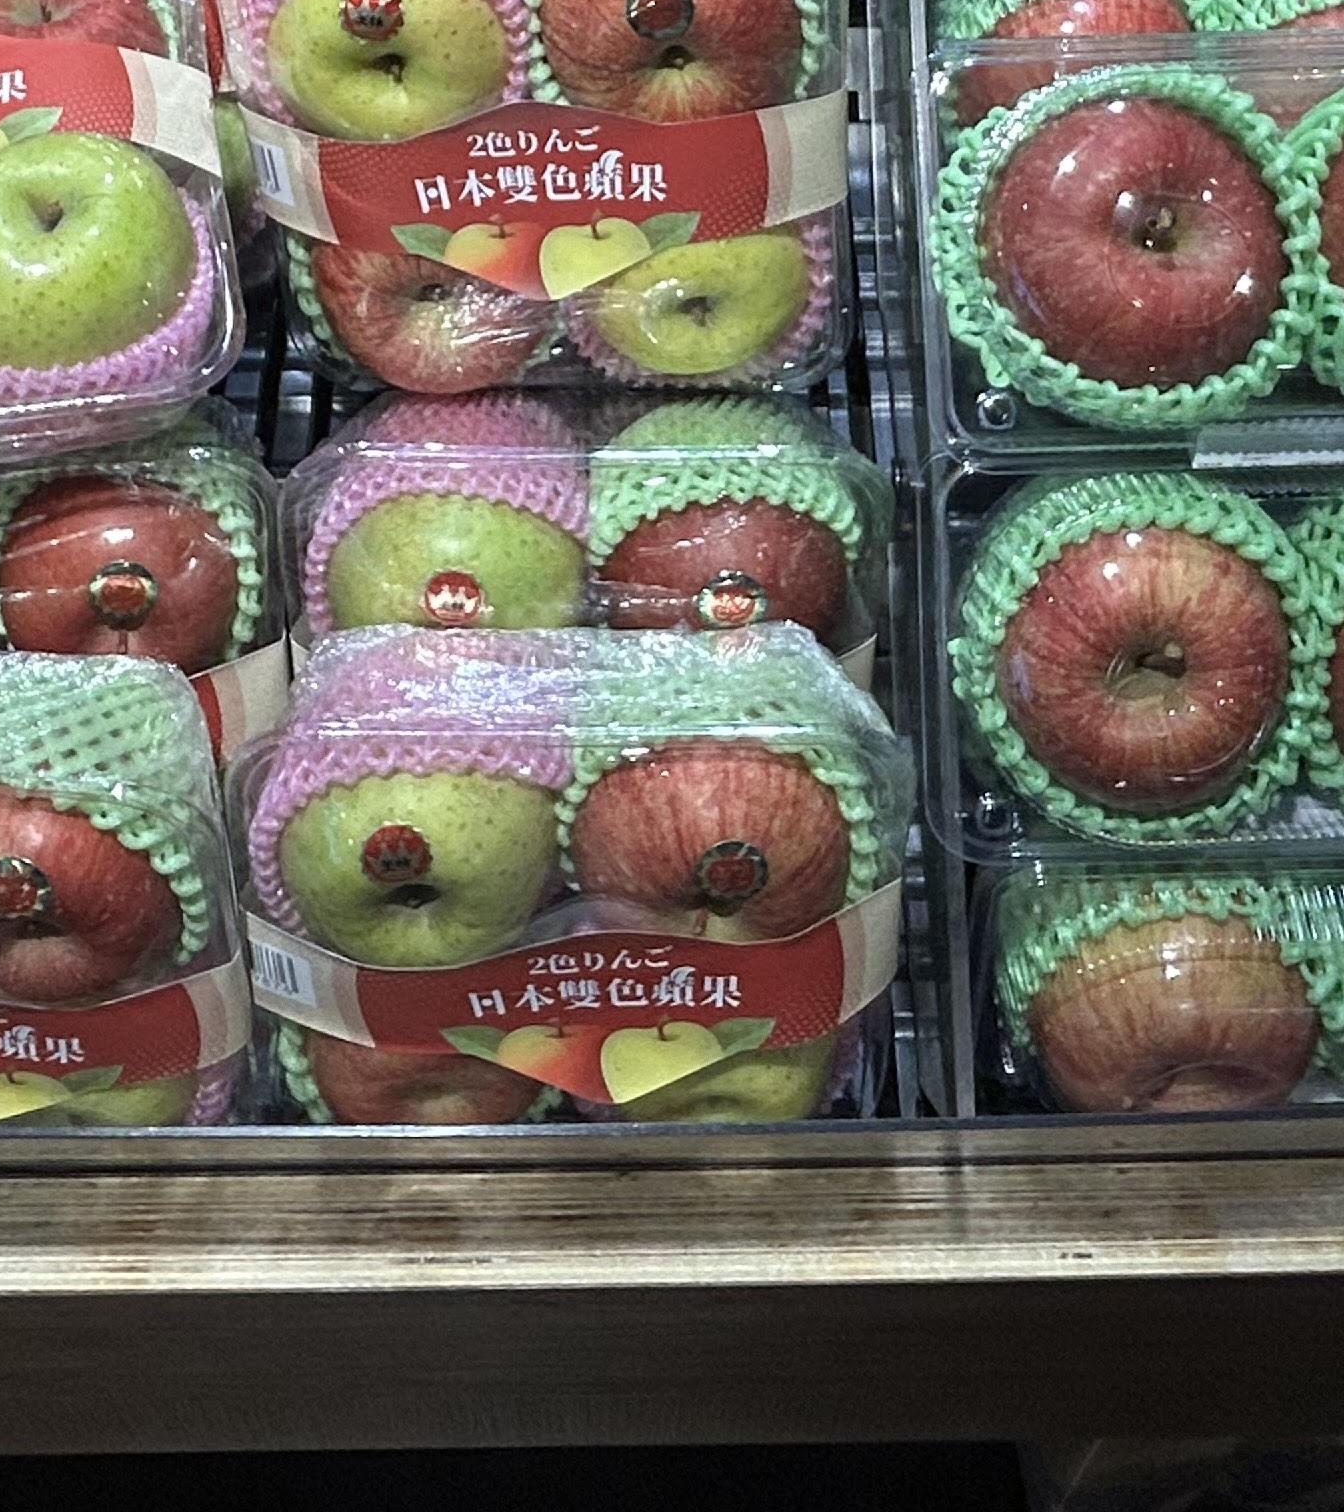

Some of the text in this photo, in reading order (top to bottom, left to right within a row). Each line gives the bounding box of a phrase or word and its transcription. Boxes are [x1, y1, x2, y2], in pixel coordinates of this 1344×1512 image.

[467, 125, 599, 158] 2色りんご
[414, 150, 667, 211] 日本雙色蘋果
[467, 968, 742, 1016] 日本雙色蘋果
